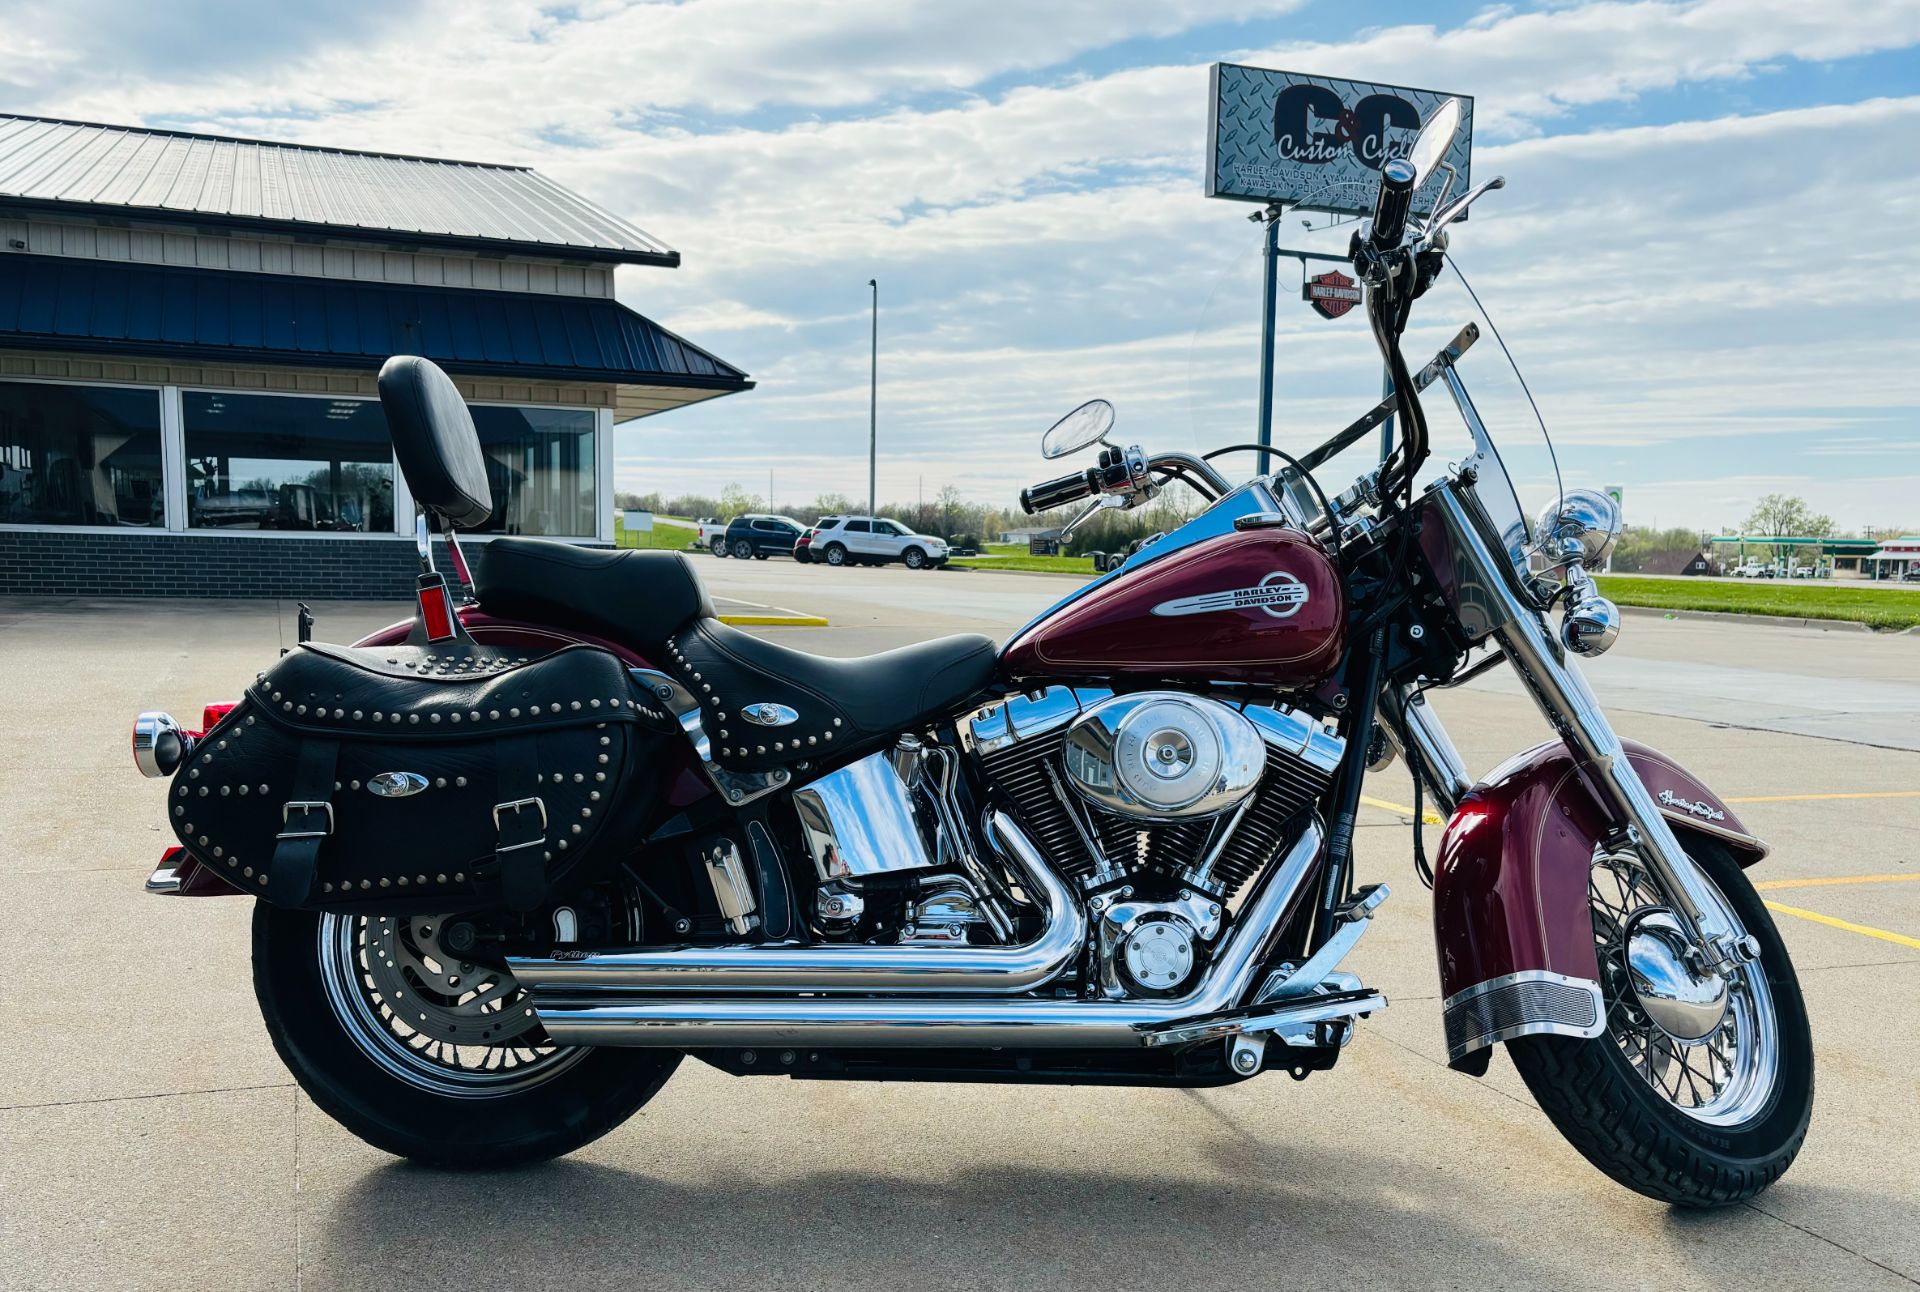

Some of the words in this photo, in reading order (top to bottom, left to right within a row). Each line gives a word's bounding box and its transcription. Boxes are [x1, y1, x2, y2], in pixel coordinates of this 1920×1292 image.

[1277, 134, 1354, 161] Custom
[1362, 134, 1411, 170] Cycl
[1233, 163, 1320, 180] HARLEY-DAVIDSON
[1240, 178, 1288, 191] KAWASAKI
[1312, 285, 1361, 300] HARLEY-DAVIDSON
[1235, 595, 1292, 607] DAVIDSON
